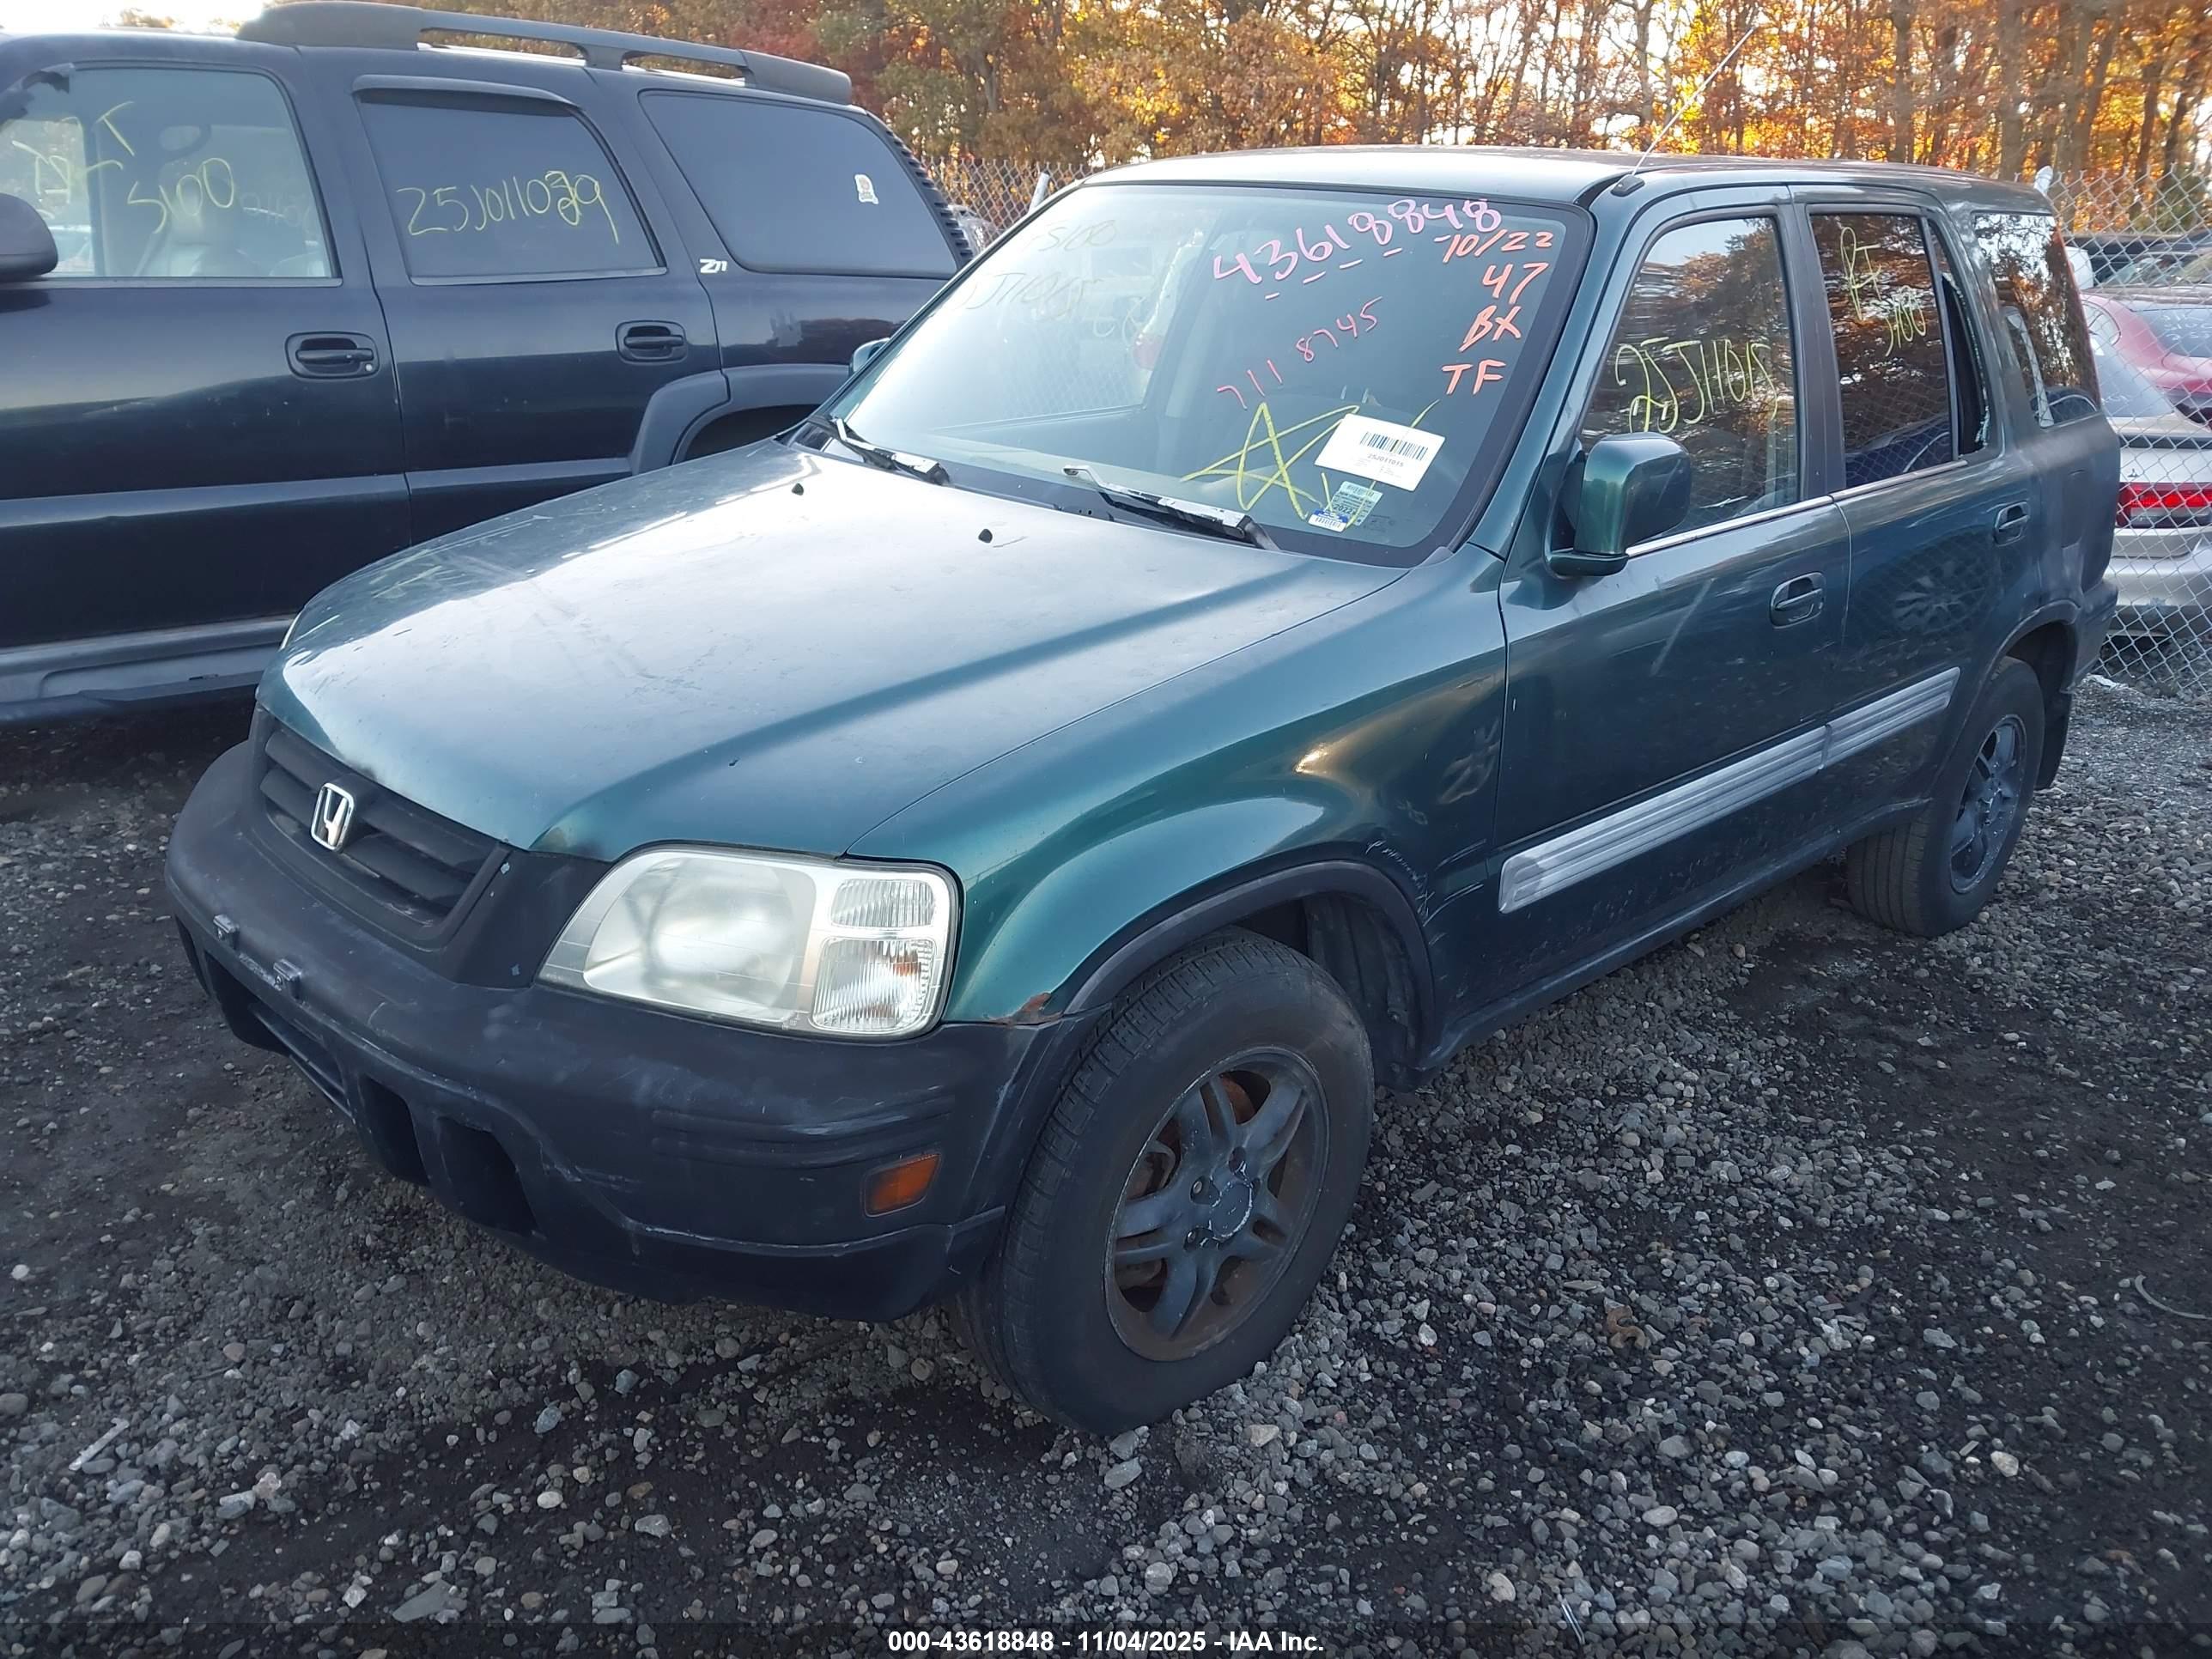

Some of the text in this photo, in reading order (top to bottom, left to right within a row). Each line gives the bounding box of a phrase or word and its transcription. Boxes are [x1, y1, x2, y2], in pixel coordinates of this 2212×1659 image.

[1212, 198, 1502, 284] 43618848
[1443, 228, 1553, 263] 10/22
[1482, 263, 1549, 304] 47
[1295, 295, 1383, 363] 8745
[1459, 305, 1522, 352] BX
[1441, 360, 1507, 395] TF
[1333, 503, 1354, 514] 2022
